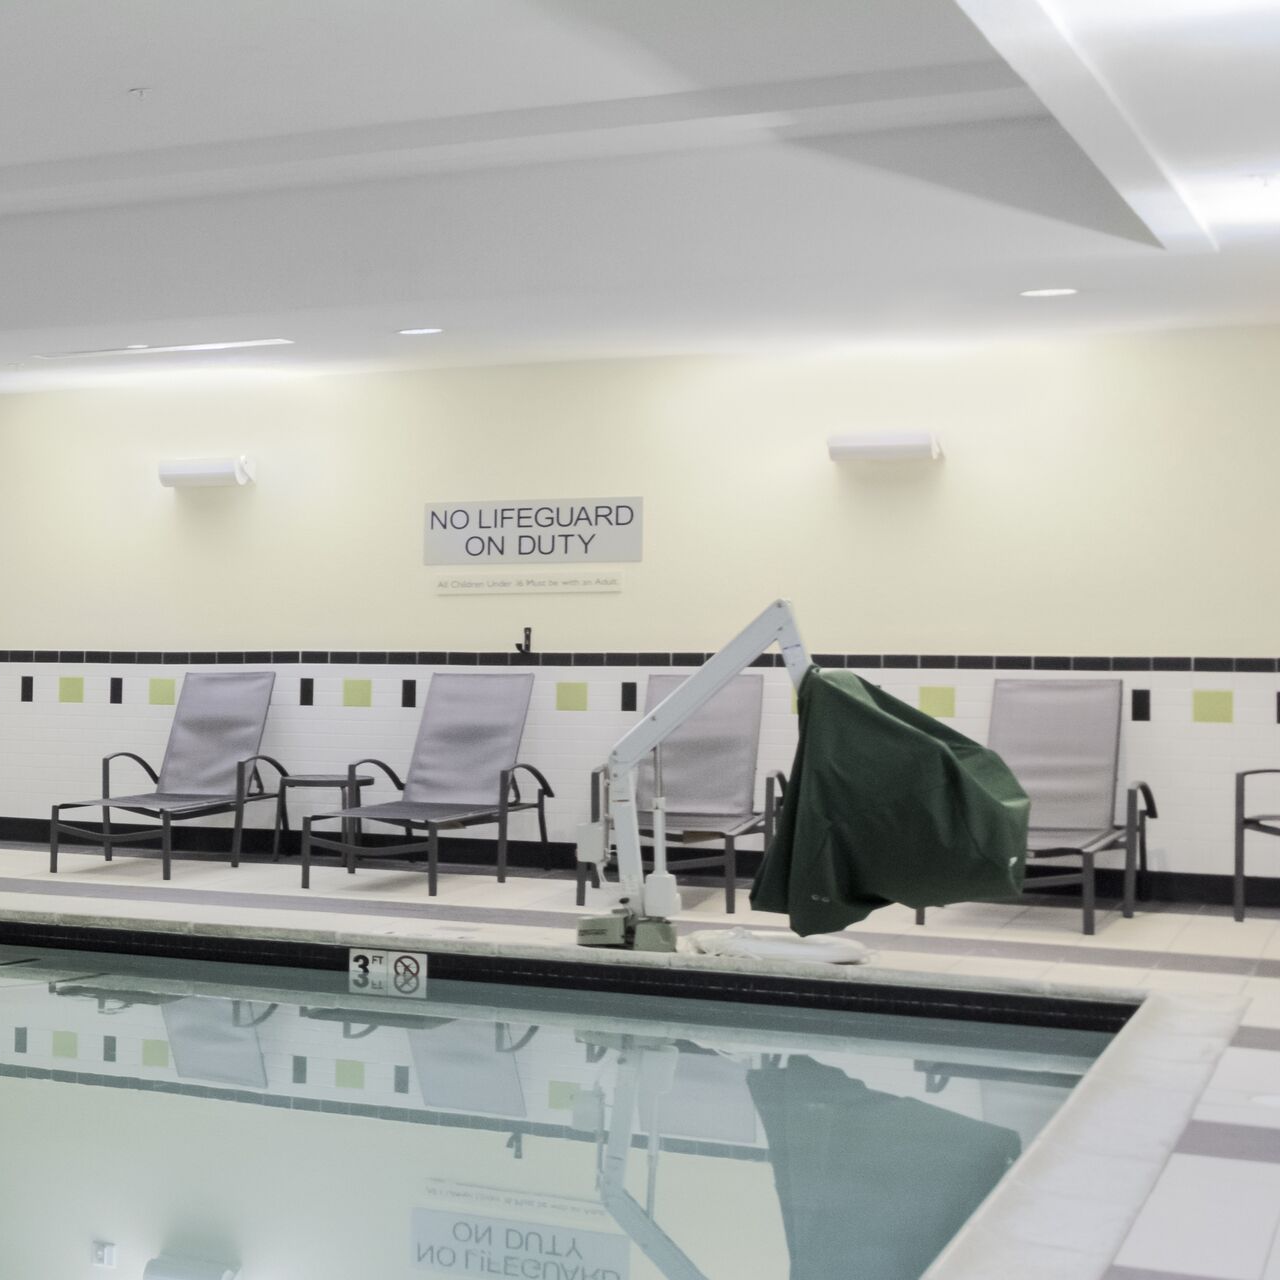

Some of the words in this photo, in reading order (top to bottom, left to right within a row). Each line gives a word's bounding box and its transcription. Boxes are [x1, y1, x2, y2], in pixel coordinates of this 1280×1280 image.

[430, 509, 470, 530] NO
[478, 505, 634, 529] LIFEGUARD
[465, 535, 505, 556] ON
[518, 533, 596, 555] DUTY
[371, 955, 384, 965] FT
